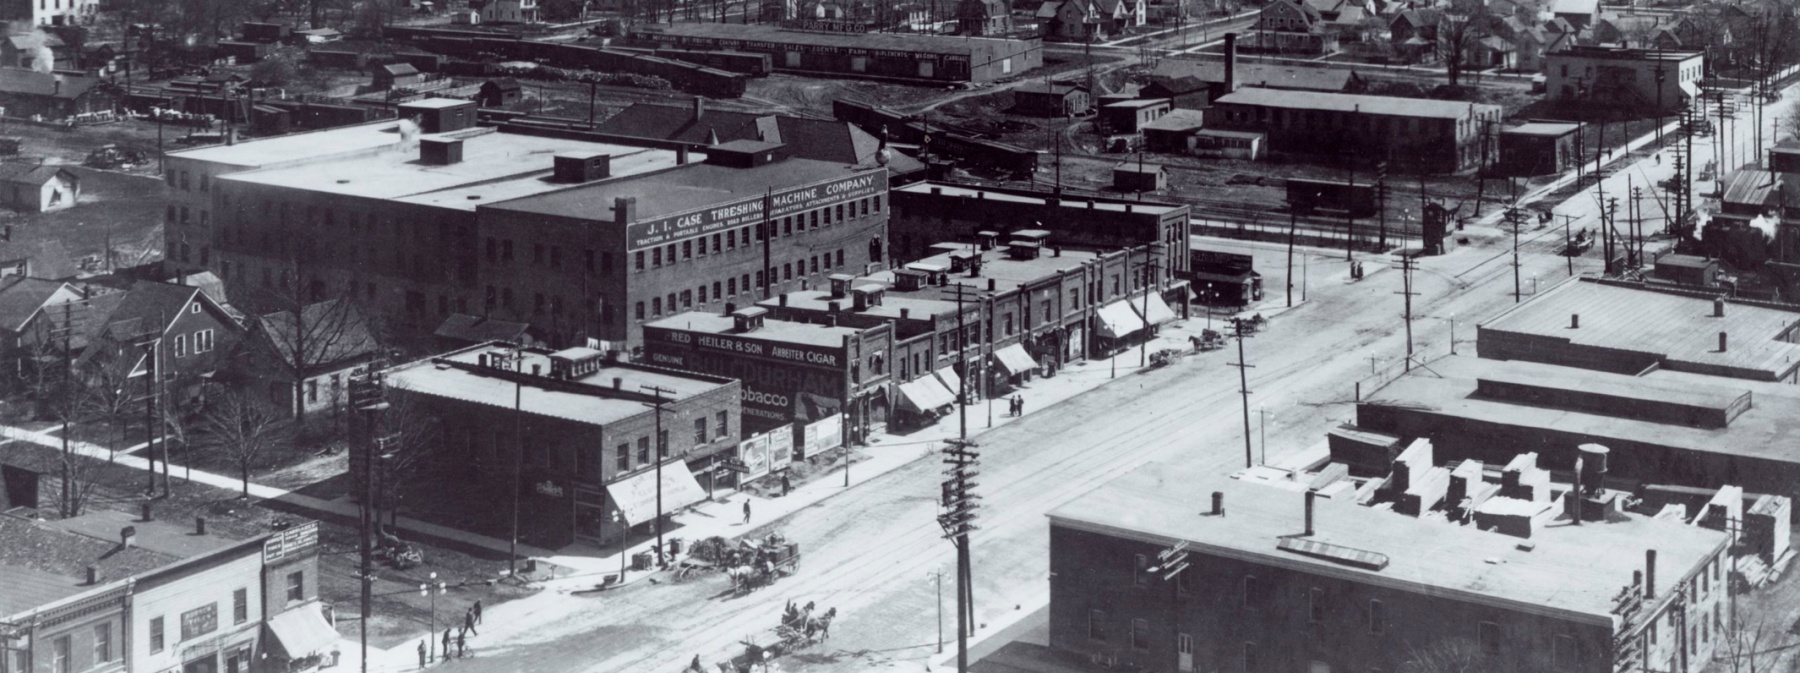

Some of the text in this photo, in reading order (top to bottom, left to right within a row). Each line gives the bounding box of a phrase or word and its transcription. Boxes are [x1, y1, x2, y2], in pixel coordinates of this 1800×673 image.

[803, 21, 829, 31] PARRY
[746, 41, 775, 49] TRANSFER
[848, 48, 867, 56] FARM
[647, 174, 874, 235] J. I. CASE THRESHING MACHINE COMPANY
[636, 234, 663, 246] TRACTION
[673, 226, 698, 238] PORTABLE
[726, 217, 739, 226] ROAD
[805, 194, 839, 207] ATTACHMENTS
[847, 186, 874, 198] SUPPLIES
[698, 335, 733, 351] HEILER
[735, 341, 743, 351] &
[745, 342, 763, 355] SON
[652, 352, 683, 366] GENUINE
[771, 345, 836, 367] ARBEITER CIGAR
[743, 357, 839, 398] DURHAM
[741, 385, 788, 407] obacco
[742, 406, 787, 421] ENERATIONS.
